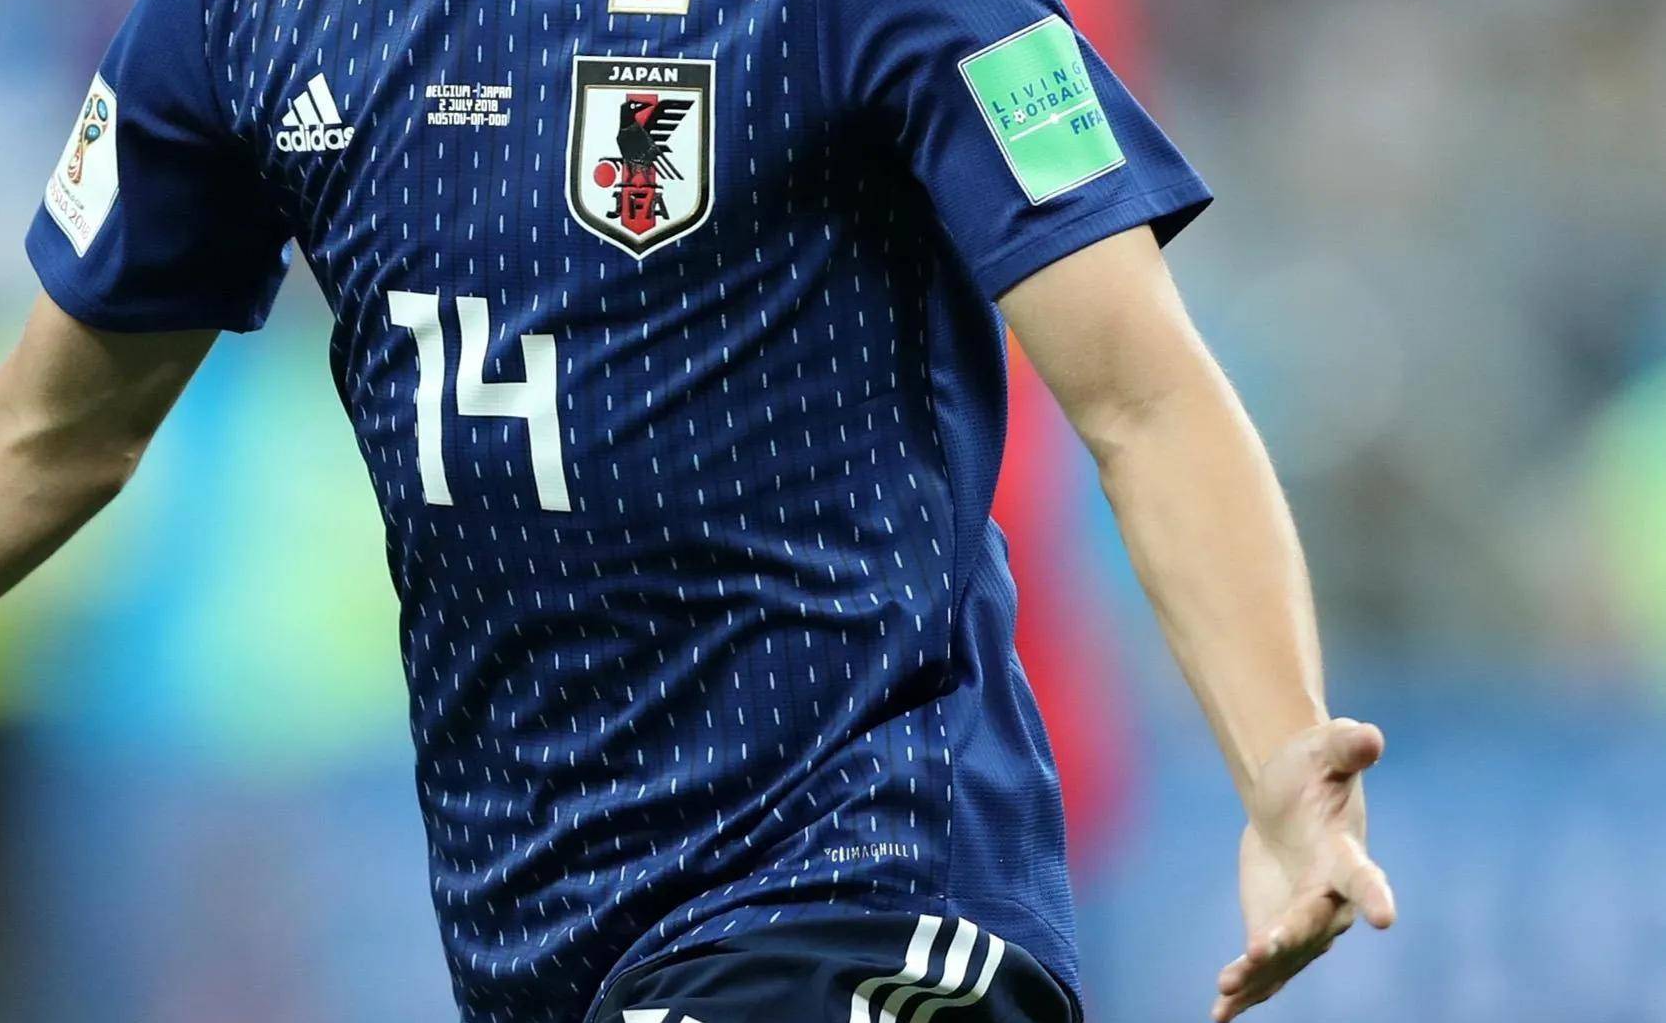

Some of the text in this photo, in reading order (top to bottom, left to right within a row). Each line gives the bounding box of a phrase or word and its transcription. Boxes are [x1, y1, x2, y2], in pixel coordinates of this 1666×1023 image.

[609, 66, 678, 82] JAPAN
[992, 61, 1082, 114] LIVING
[425, 85, 471, 98] BELGIUM
[480, 85, 512, 99] JAPAN
[439, 99, 498, 112] 2 JULY 2018
[1069, 108, 1104, 135] FIFA
[276, 122, 355, 152] adidas
[606, 191, 670, 220] JFA
[387, 290, 572, 512] 14
